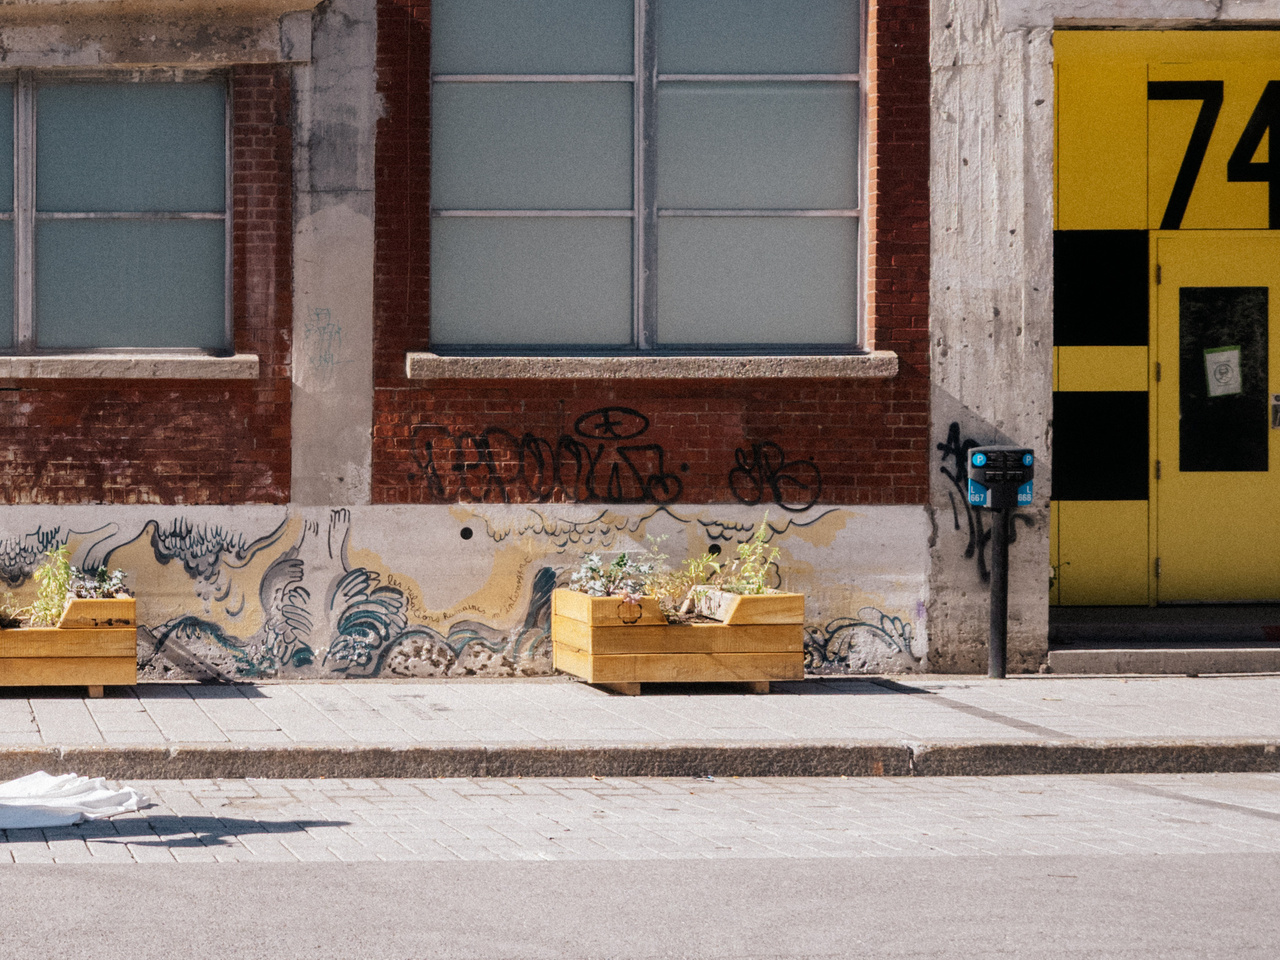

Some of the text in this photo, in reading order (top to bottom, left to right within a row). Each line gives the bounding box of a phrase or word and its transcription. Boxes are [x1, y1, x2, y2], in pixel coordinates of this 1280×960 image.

[1147, 80, 1280, 230] 74
[970, 494, 984, 502] 667
[1017, 494, 1032, 502] 668
[387, 574, 402, 589] les
